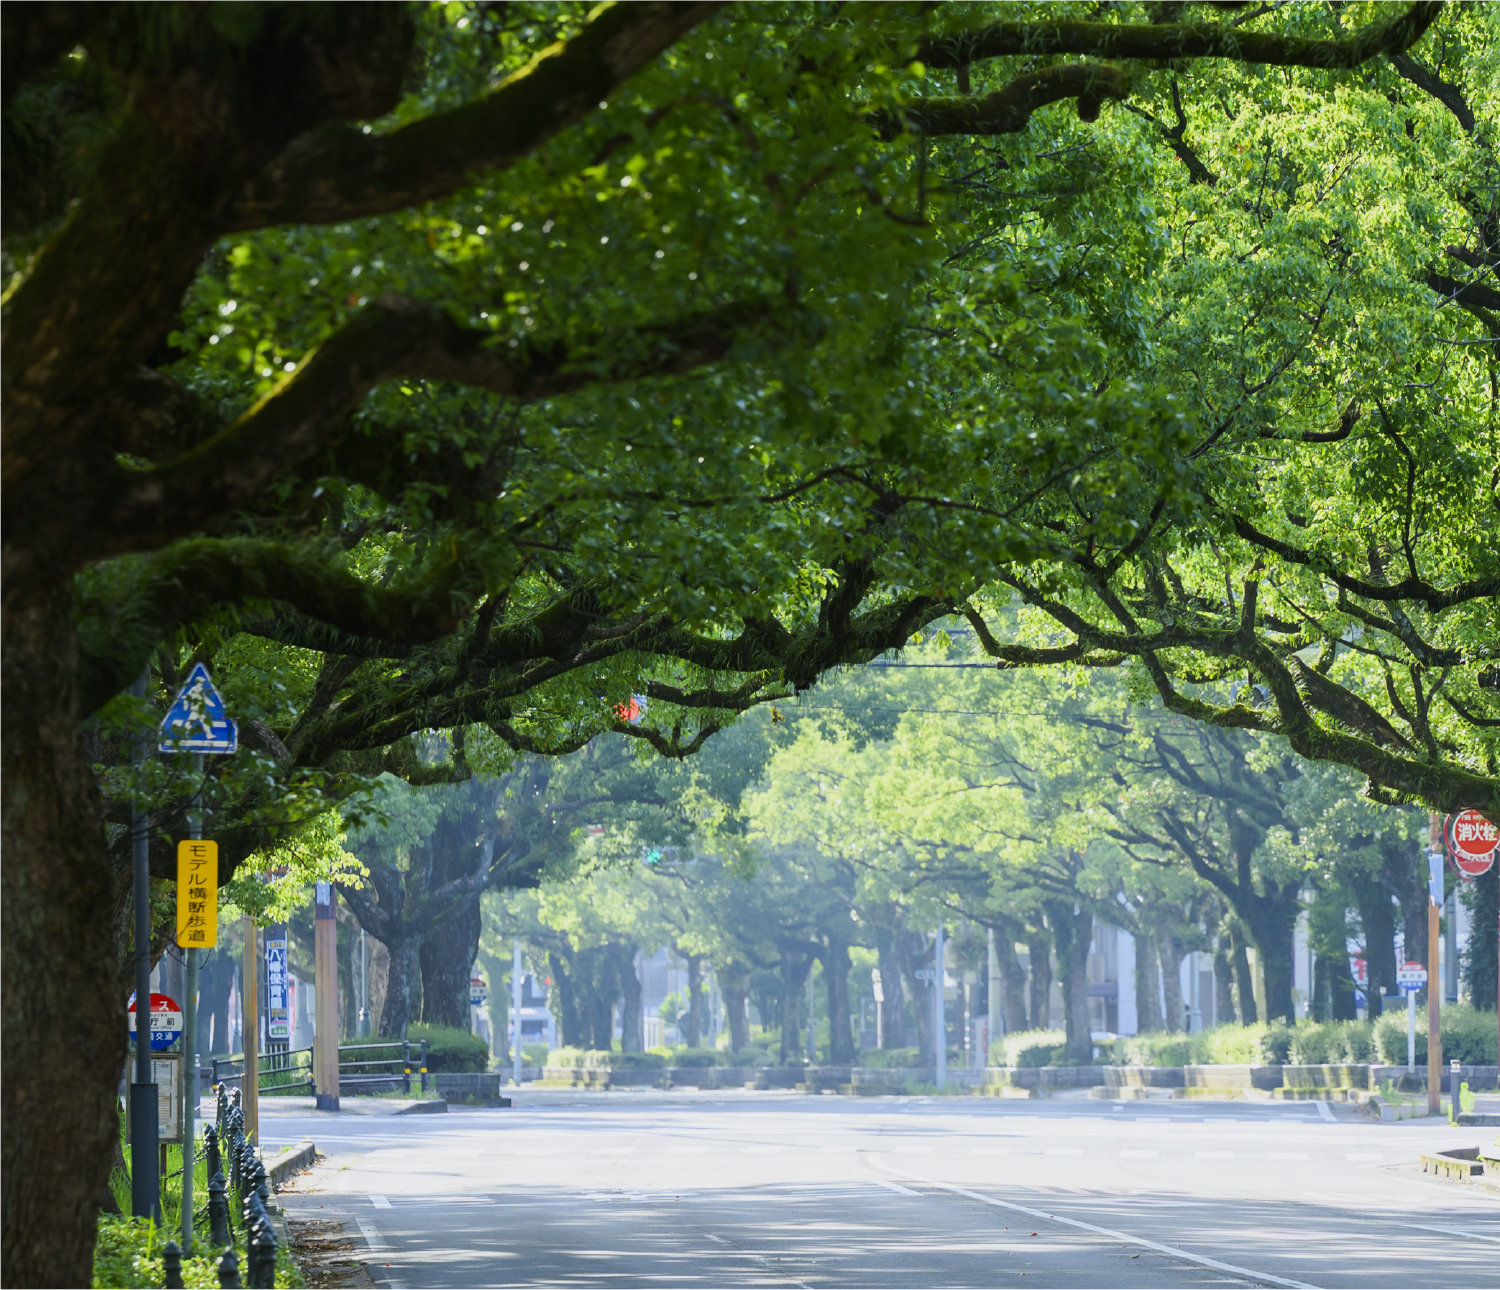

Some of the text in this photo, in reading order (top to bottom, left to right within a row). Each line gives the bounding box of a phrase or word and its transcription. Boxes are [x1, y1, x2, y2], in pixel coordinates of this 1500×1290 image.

[1458, 822, 1497, 841] 消火栓
[188, 845, 207, 941] モデル横断歩道
[147, 1018, 174, 1026] 庁前
[150, 1032, 173, 1041] 交通
